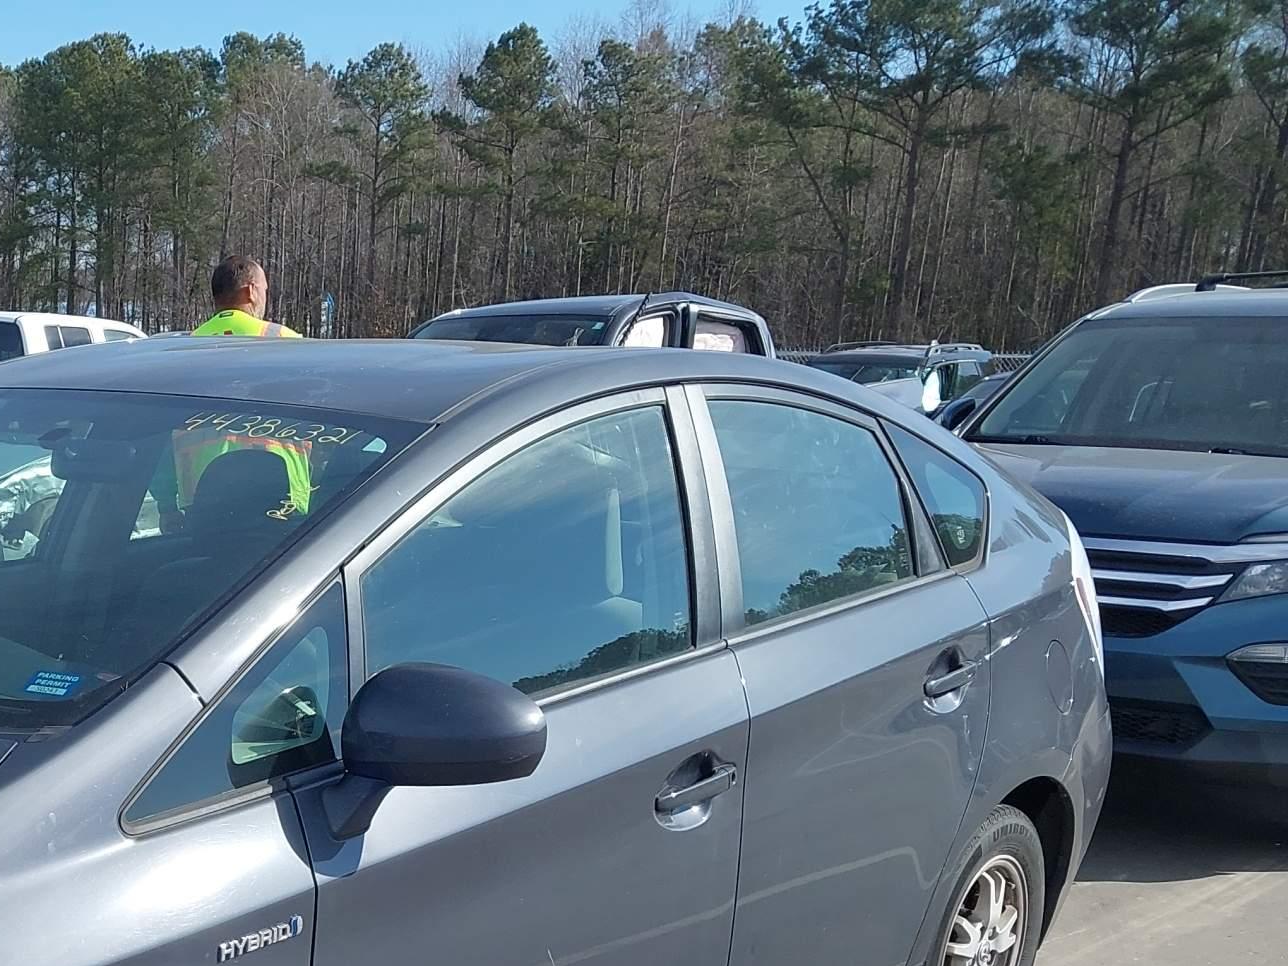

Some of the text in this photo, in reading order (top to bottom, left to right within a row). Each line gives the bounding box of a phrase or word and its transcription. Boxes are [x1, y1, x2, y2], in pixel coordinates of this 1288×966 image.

[184, 412, 363, 445] 44386321
[34, 679, 71, 687] PERMIT
[37, 672, 79, 682] PARKING
[217, 922, 292, 963] HYBRID
